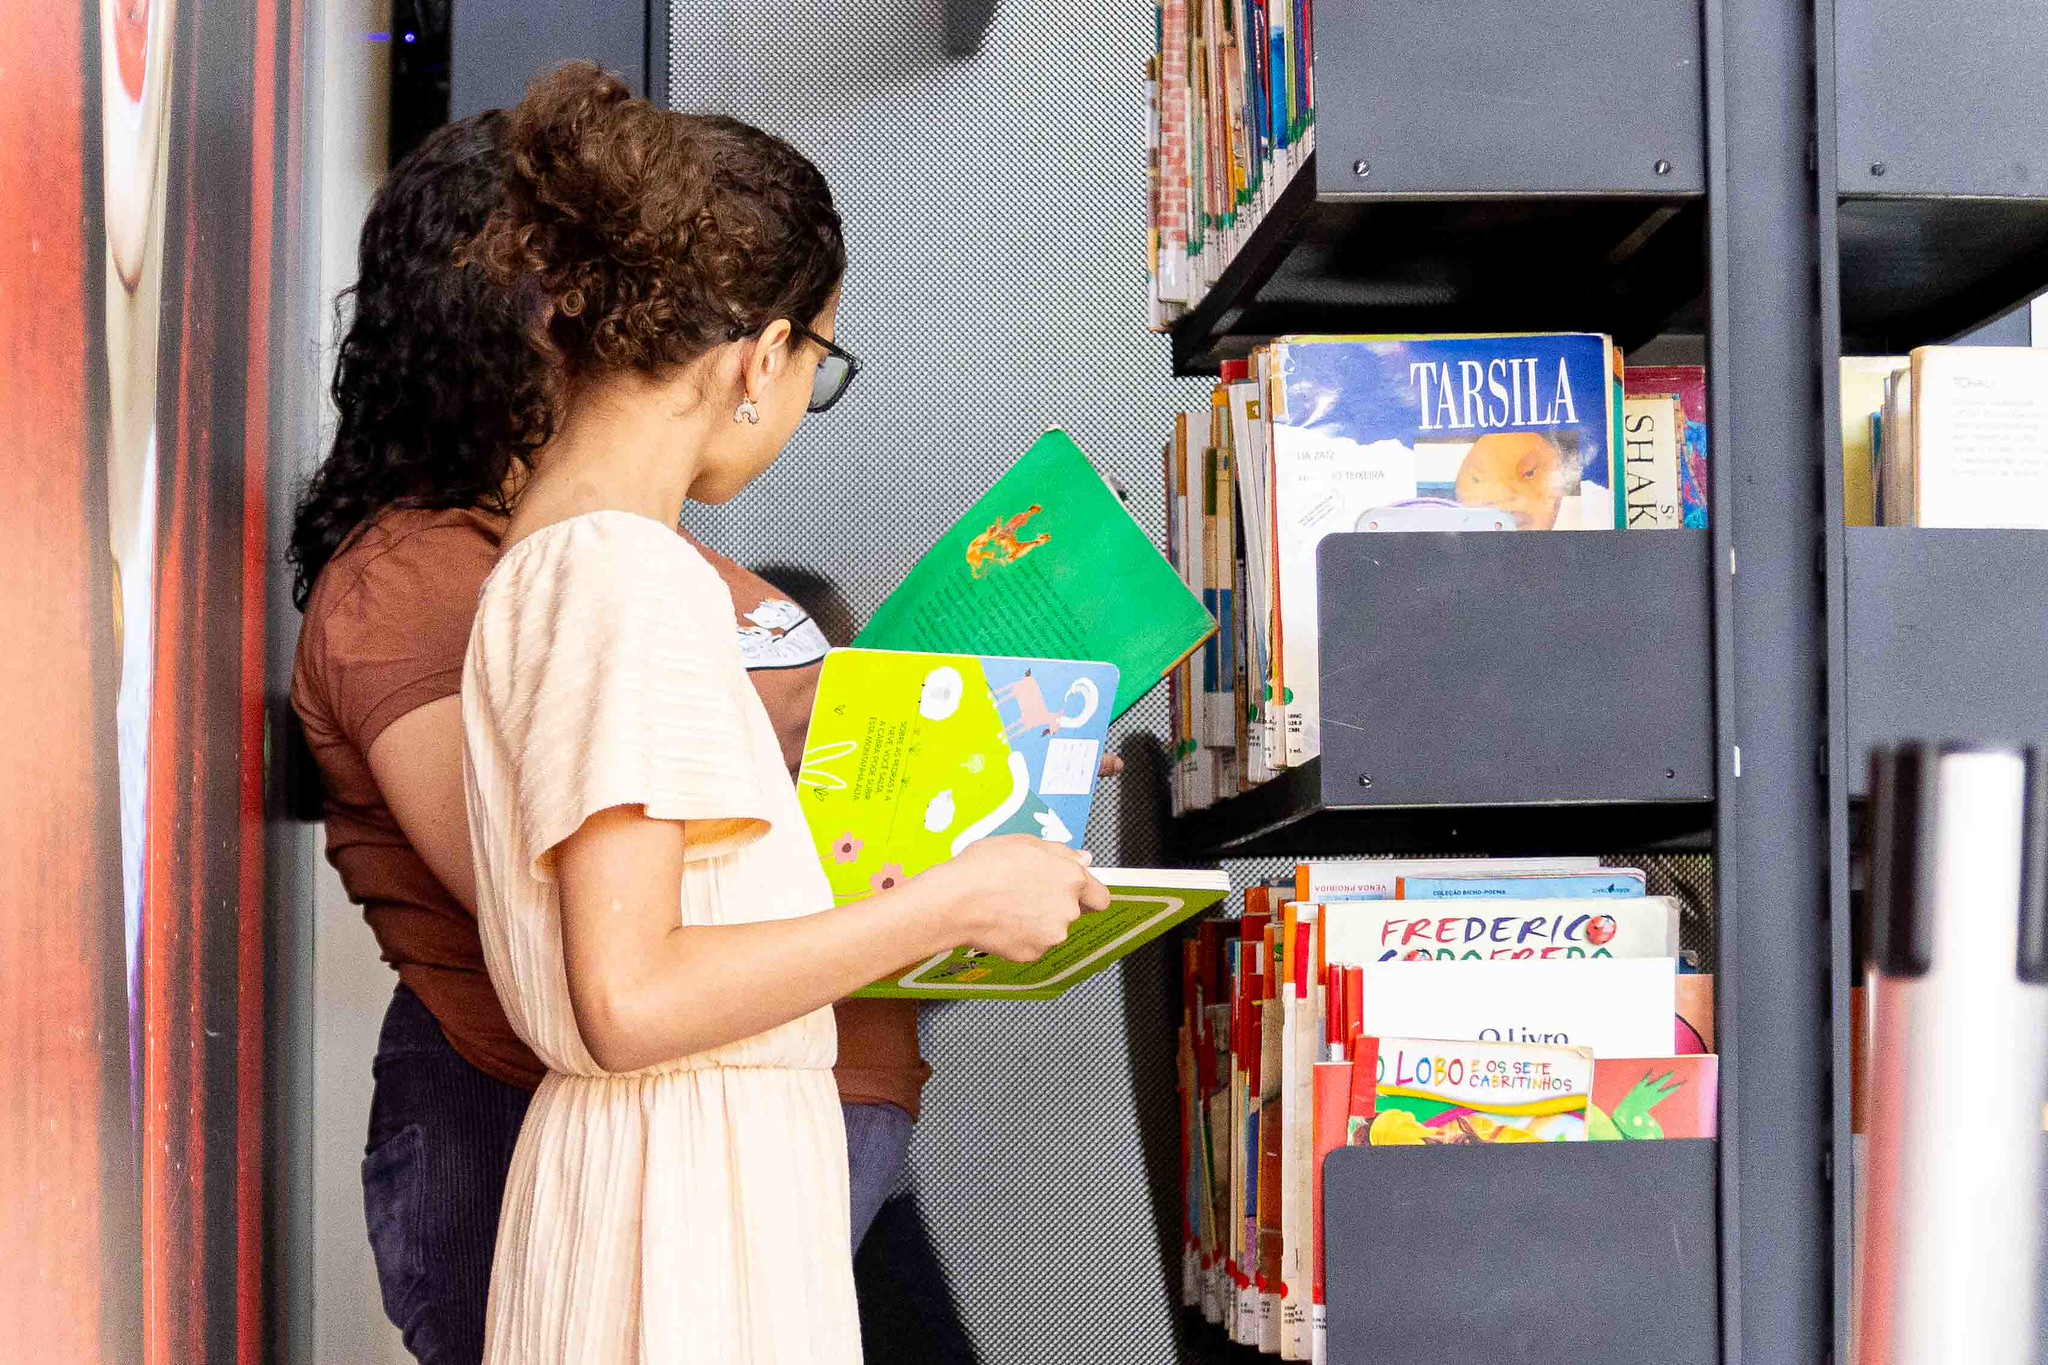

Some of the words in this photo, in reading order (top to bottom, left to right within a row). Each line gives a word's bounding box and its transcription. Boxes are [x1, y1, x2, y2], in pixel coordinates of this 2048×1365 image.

[1409, 356, 1580, 431] TARSILA
[1625, 413, 1658, 526] SHAK
[874, 728, 885, 754] CABRA
[868, 755, 879, 776] PODE
[1314, 884, 1355, 892] PROIBIDA
[1357, 884, 1386, 892] VENDA
[1381, 914, 1617, 947] FREDERICO
[1395, 1050, 1464, 1086] LOBO
[1470, 1060, 1480, 1073] E
[1486, 1060, 1507, 1074] OS
[1512, 1061, 1552, 1076] SETE
[1469, 1074, 1573, 1092] CABRITINHOS
